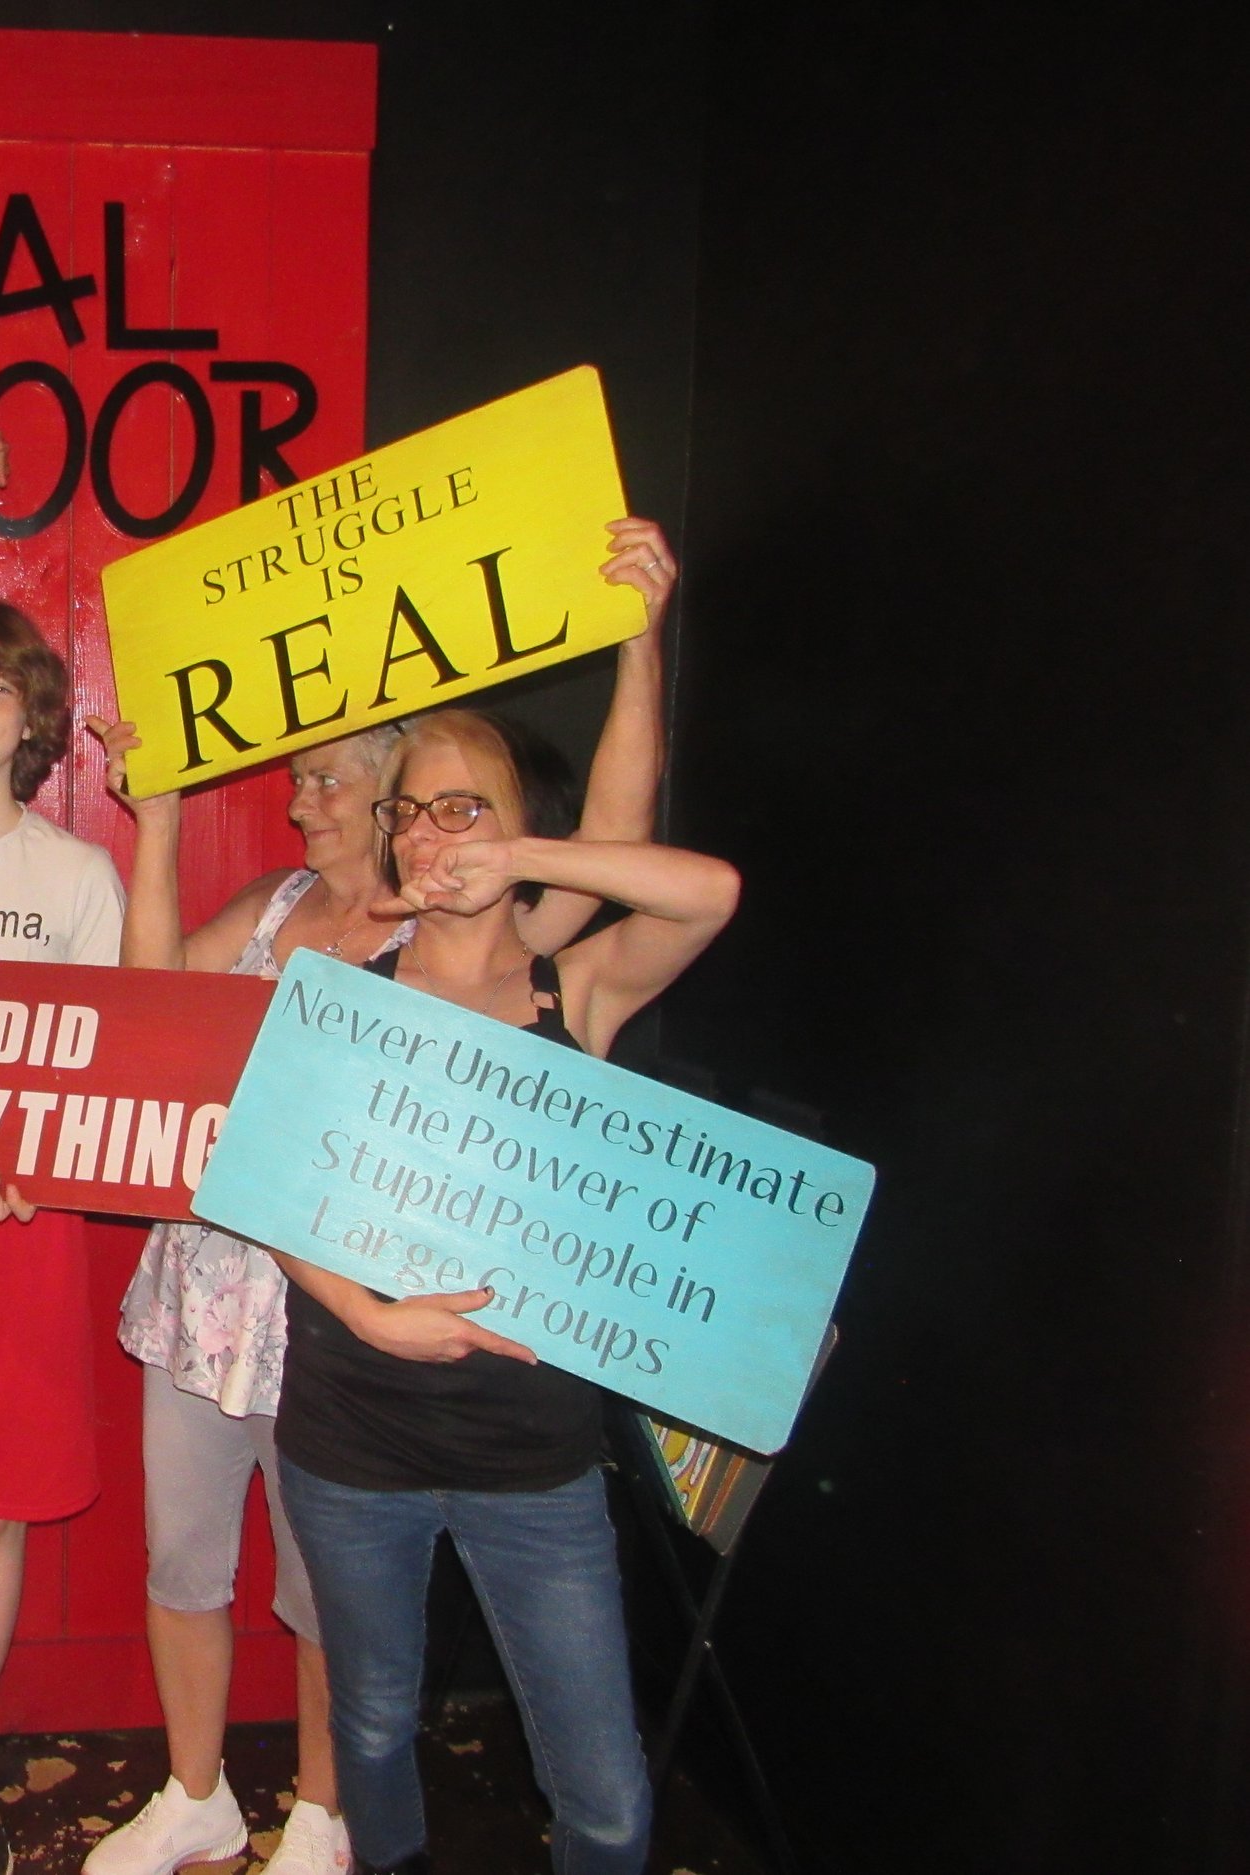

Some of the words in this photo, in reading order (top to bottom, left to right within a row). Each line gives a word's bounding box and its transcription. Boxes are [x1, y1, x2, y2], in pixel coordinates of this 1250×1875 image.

[204, 467, 479, 606] STRUGGLE
[277, 462, 380, 530] THE
[320, 556, 364, 603] IS
[163, 546, 570, 774] REAL
[281, 979, 439, 1066] Never
[445, 1039, 847, 1228] Underestimate
[368, 1079, 450, 1146] the
[457, 1115, 637, 1213] Power
[647, 1197, 715, 1244] of
[309, 1195, 465, 1292] Large
[477, 1266, 670, 1375] Groups
[312, 1129, 485, 1229] Stupid
[488, 1195, 657, 1299] People
[666, 1266, 716, 1323] in
